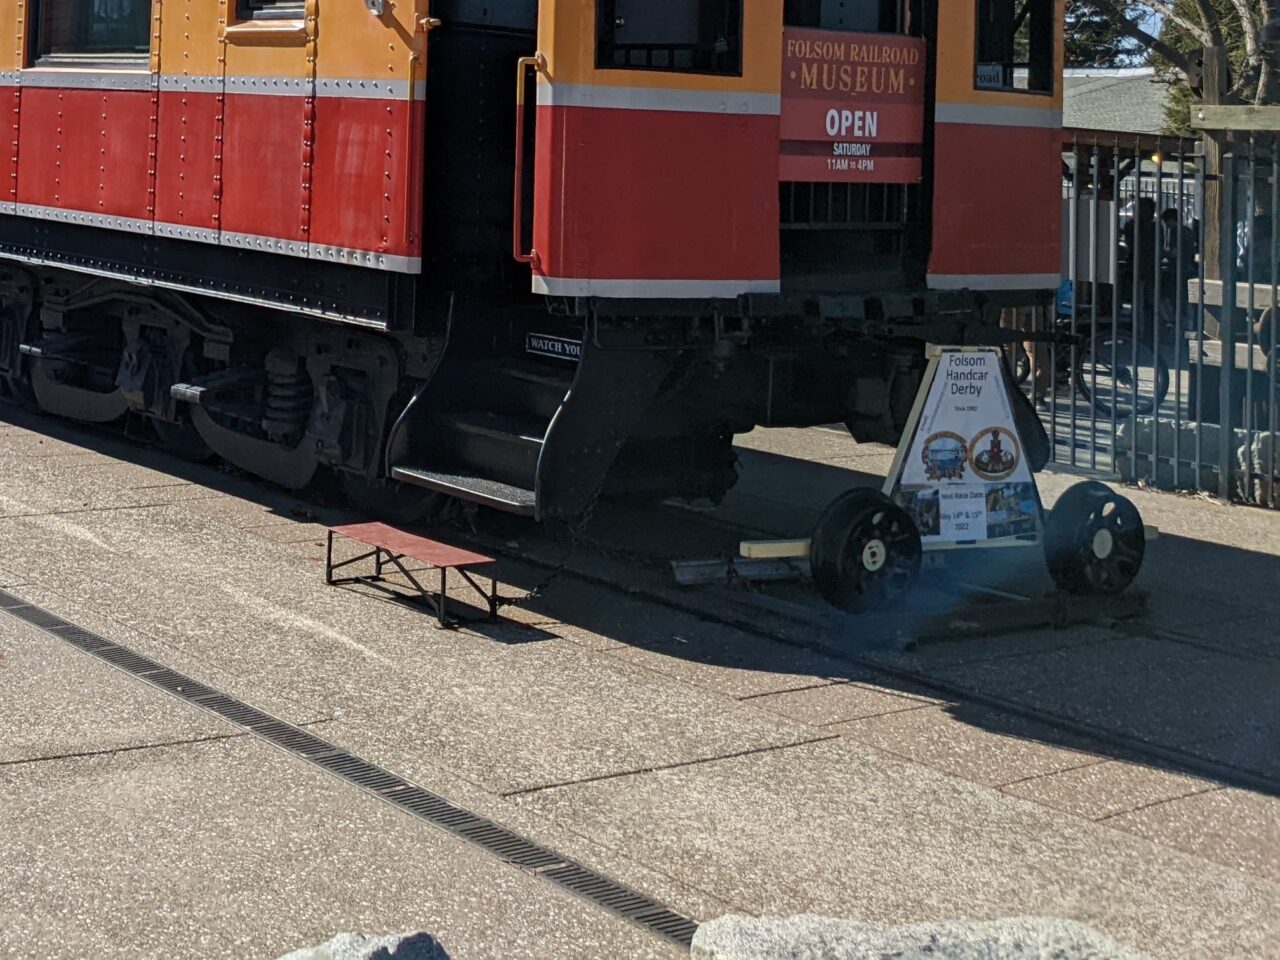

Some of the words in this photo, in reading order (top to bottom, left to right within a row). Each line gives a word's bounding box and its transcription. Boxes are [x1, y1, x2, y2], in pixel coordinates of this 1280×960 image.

[787, 39, 845, 62] FOLSOM
[849, 43, 919, 65] RAILROAD
[800, 62, 905, 94] MUSEUM
[825, 108, 878, 137] OPEN
[833, 142, 871, 156] SATURDAY
[827, 158, 848, 171] 11AM
[857, 159, 874, 171] 4PM
[531, 338, 562, 353] WATCH
[949, 354, 986, 367] Folsom
[946, 368, 989, 381] Handcar
[951, 382, 982, 397] Derby
